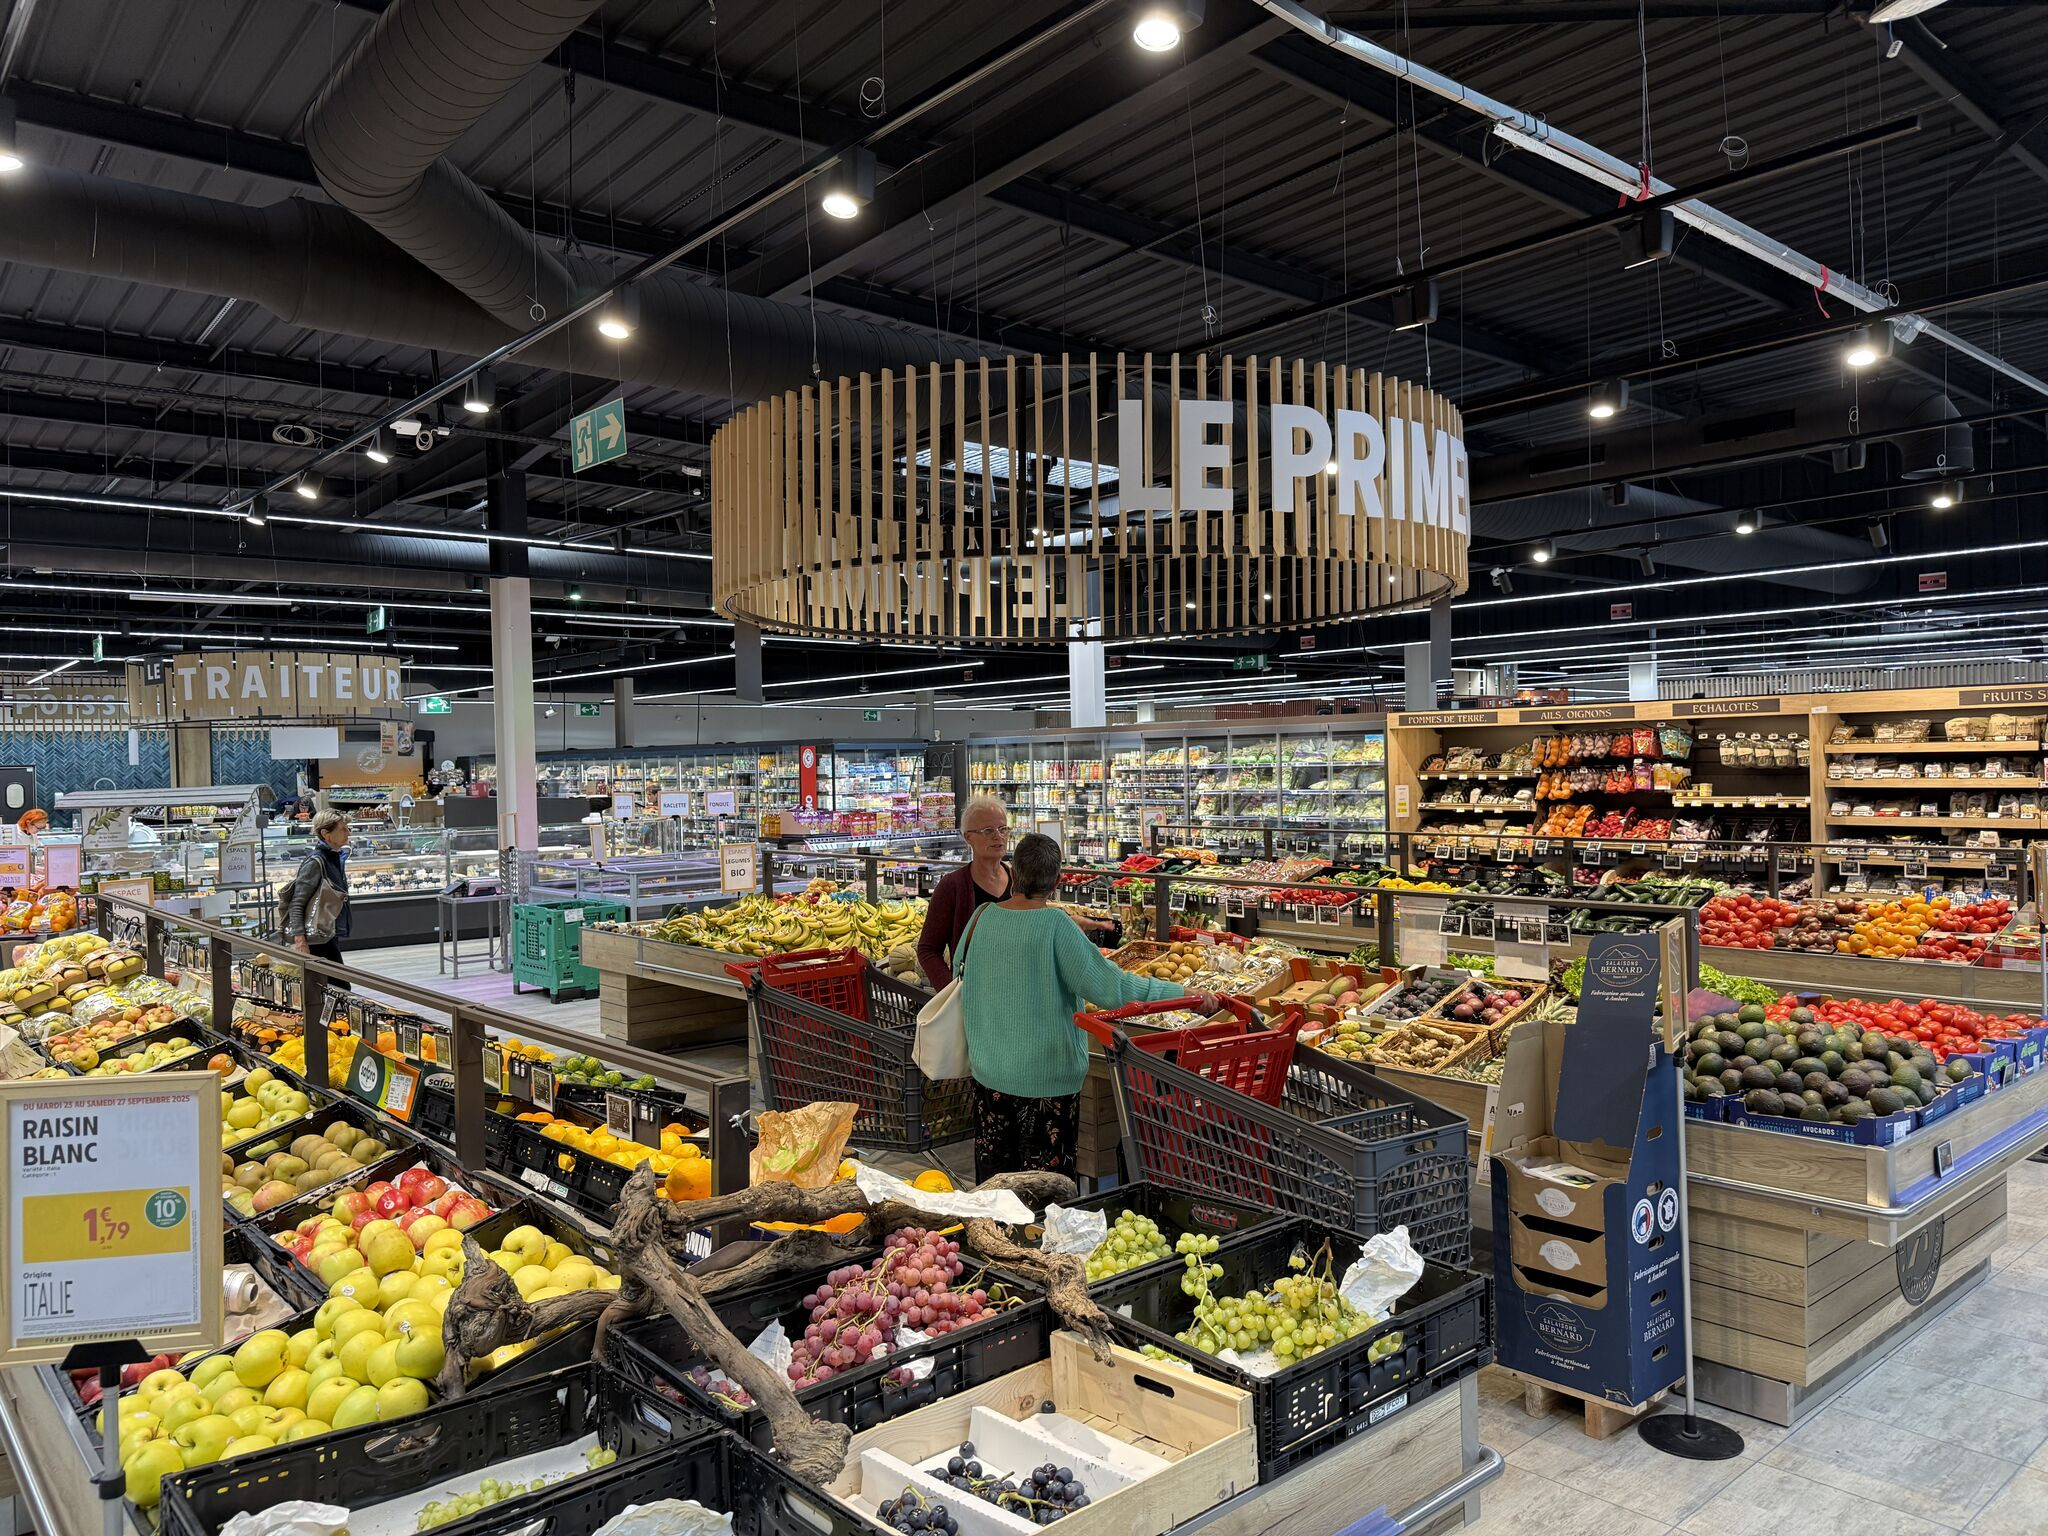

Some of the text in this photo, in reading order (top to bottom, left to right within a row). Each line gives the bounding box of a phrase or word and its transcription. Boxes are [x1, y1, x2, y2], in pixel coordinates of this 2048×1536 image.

[1119, 400, 1471, 547] LE PRIME
[147, 663, 401, 700] LE TRAITEUR
[1983, 689, 2048, 702] FRUITS S
[1566, 709, 1612, 719] OIGNONS
[1692, 701, 1759, 713] ECHALOTES
[1408, 715, 1442, 724] POMMES
[1443, 715, 1455, 723] DE
[730, 868, 746, 877] BIO
[1600, 966, 1643, 974] BERNARD
[23, 1095, 190, 1111] DU MARDI 23 AU SAMEDI 27 SEPTEMBRE 2025
[23, 1116, 98, 1139] RAISIN
[1802, 1126, 1835, 1136] AVOCADOS
[23, 1142, 98, 1166] BLANC
[23, 1271, 52, 1279] Origine
[24, 1280, 74, 1318] ITALIE
[1543, 1318, 1577, 1332] SALAISONS
[1646, 1310, 1671, 1329] SALAISONS
[1540, 1323, 1583, 1341] BERNARD
[1643, 1317, 1675, 1342] BERNARD
